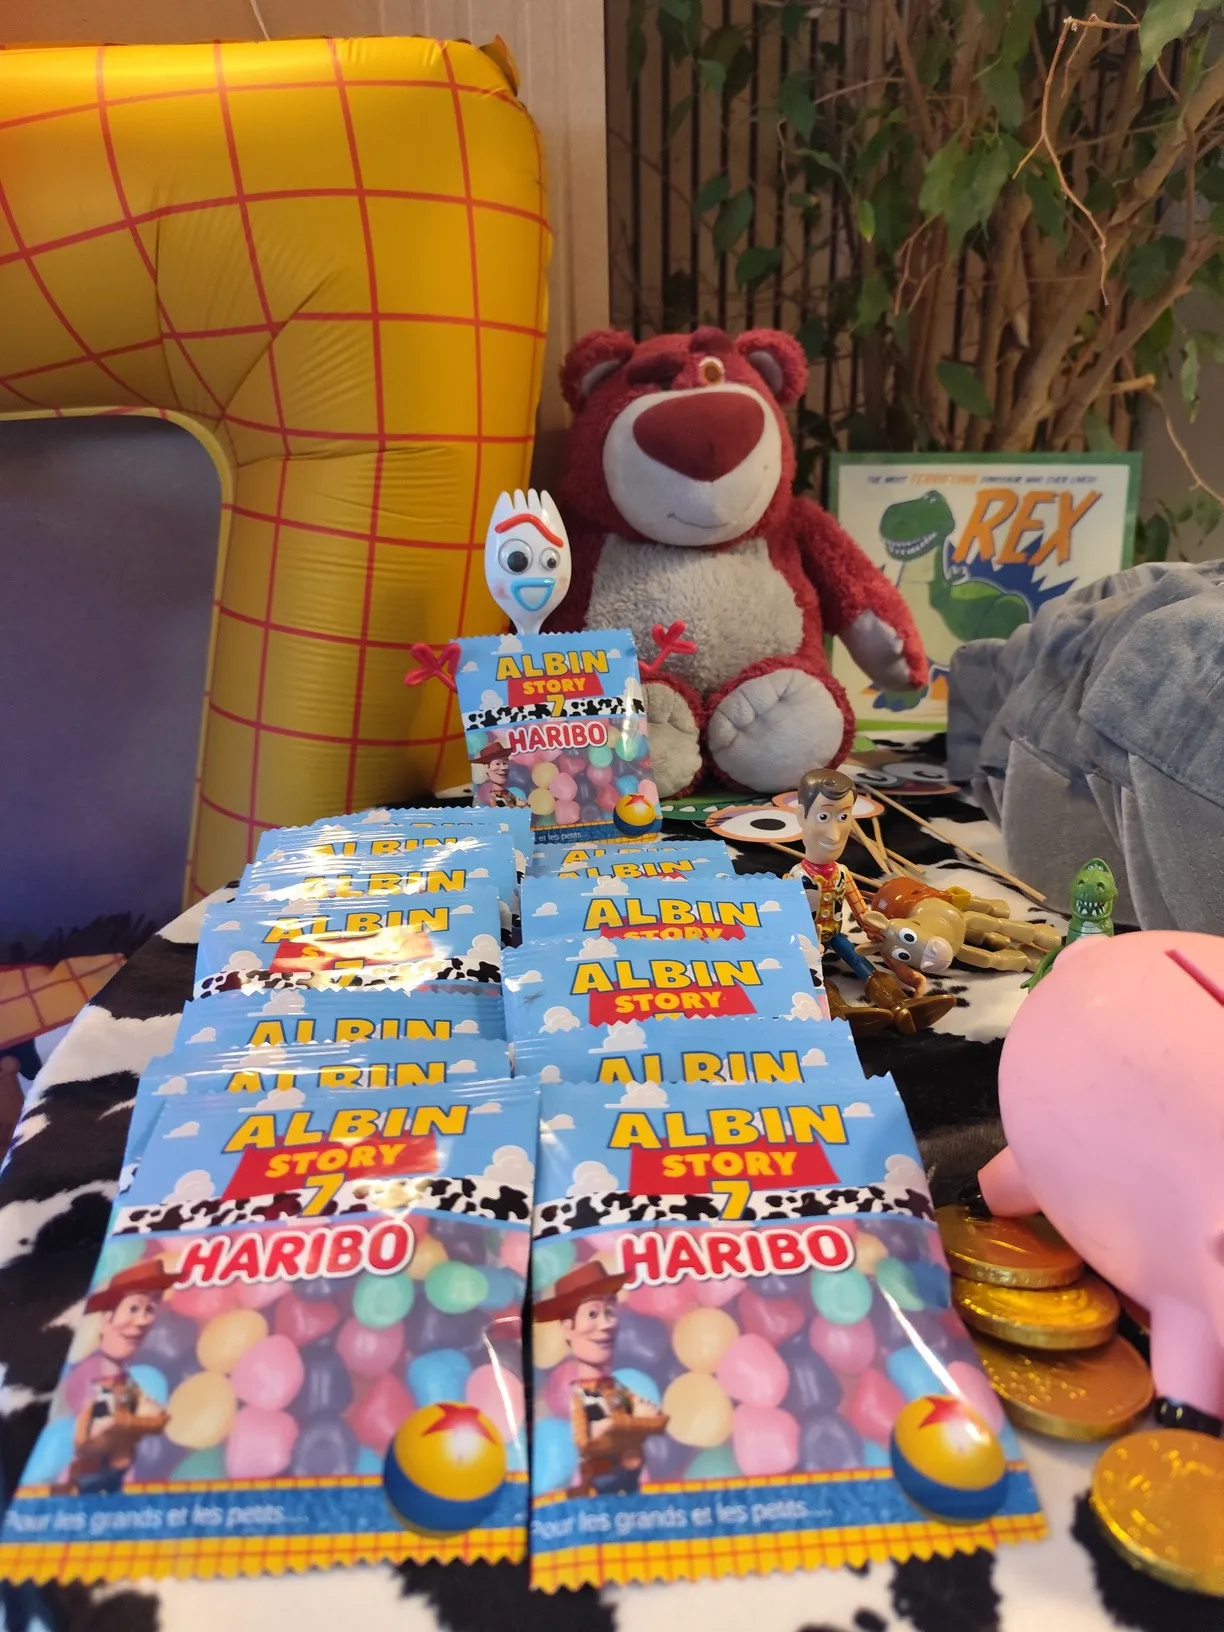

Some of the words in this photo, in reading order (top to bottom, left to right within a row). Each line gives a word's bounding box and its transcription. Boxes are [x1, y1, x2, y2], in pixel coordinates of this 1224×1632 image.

[952, 488, 1102, 565] REX
[496, 650, 610, 681] ALBIN
[522, 677, 586, 695] STORY
[546, 694, 565, 718] 7
[507, 721, 608, 755] HARIBO
[303, 869, 467, 898] ALBIN
[262, 907, 450, 943] ALBIN
[583, 897, 762, 931] ALBIN
[570, 959, 763, 995] ALBIN
[615, 991, 722, 1014] STORY
[222, 1104, 471, 1154] ALBIN
[607, 1104, 850, 1149] ALBIN
[265, 1143, 406, 1178] STORY
[661, 1150, 798, 1178] STORY
[299, 1172, 348, 1218] 7
[709, 1179, 752, 1221] 7
[176, 1221, 413, 1289] HARIBO
[618, 1225, 854, 1289] HARIBO
[89, 1507, 163, 1536] grands
[578, 1510, 611, 1533] les
[614, 1506, 687, 1537] grands
[715, 1502, 748, 1525] les
